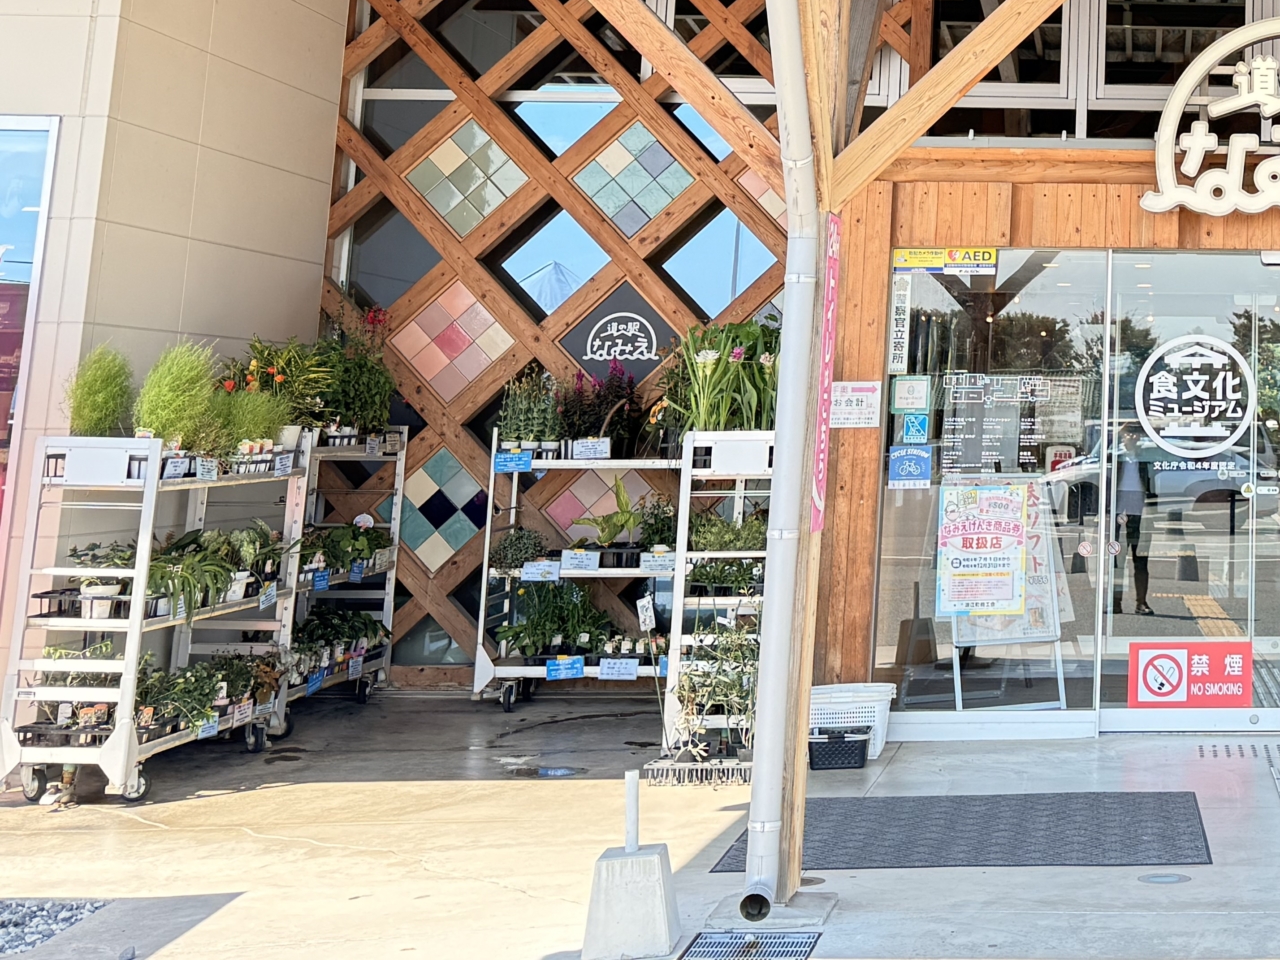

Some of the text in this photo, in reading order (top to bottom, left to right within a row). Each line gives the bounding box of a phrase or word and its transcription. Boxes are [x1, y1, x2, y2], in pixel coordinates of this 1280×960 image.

[961, 251, 992, 262] AED
[602, 322, 644, 335] 道の駅
[891, 294, 907, 364] 警察官立寄所
[592, 337, 650, 360] なみえ
[1149, 370, 1242, 400] 食文化
[1148, 400, 1243, 418] ミュージアム
[943, 520, 1021, 535] なみえげんき商品券
[961, 537, 1003, 550] 取扱店
[1191, 683, 1243, 695] NO SMOKING
